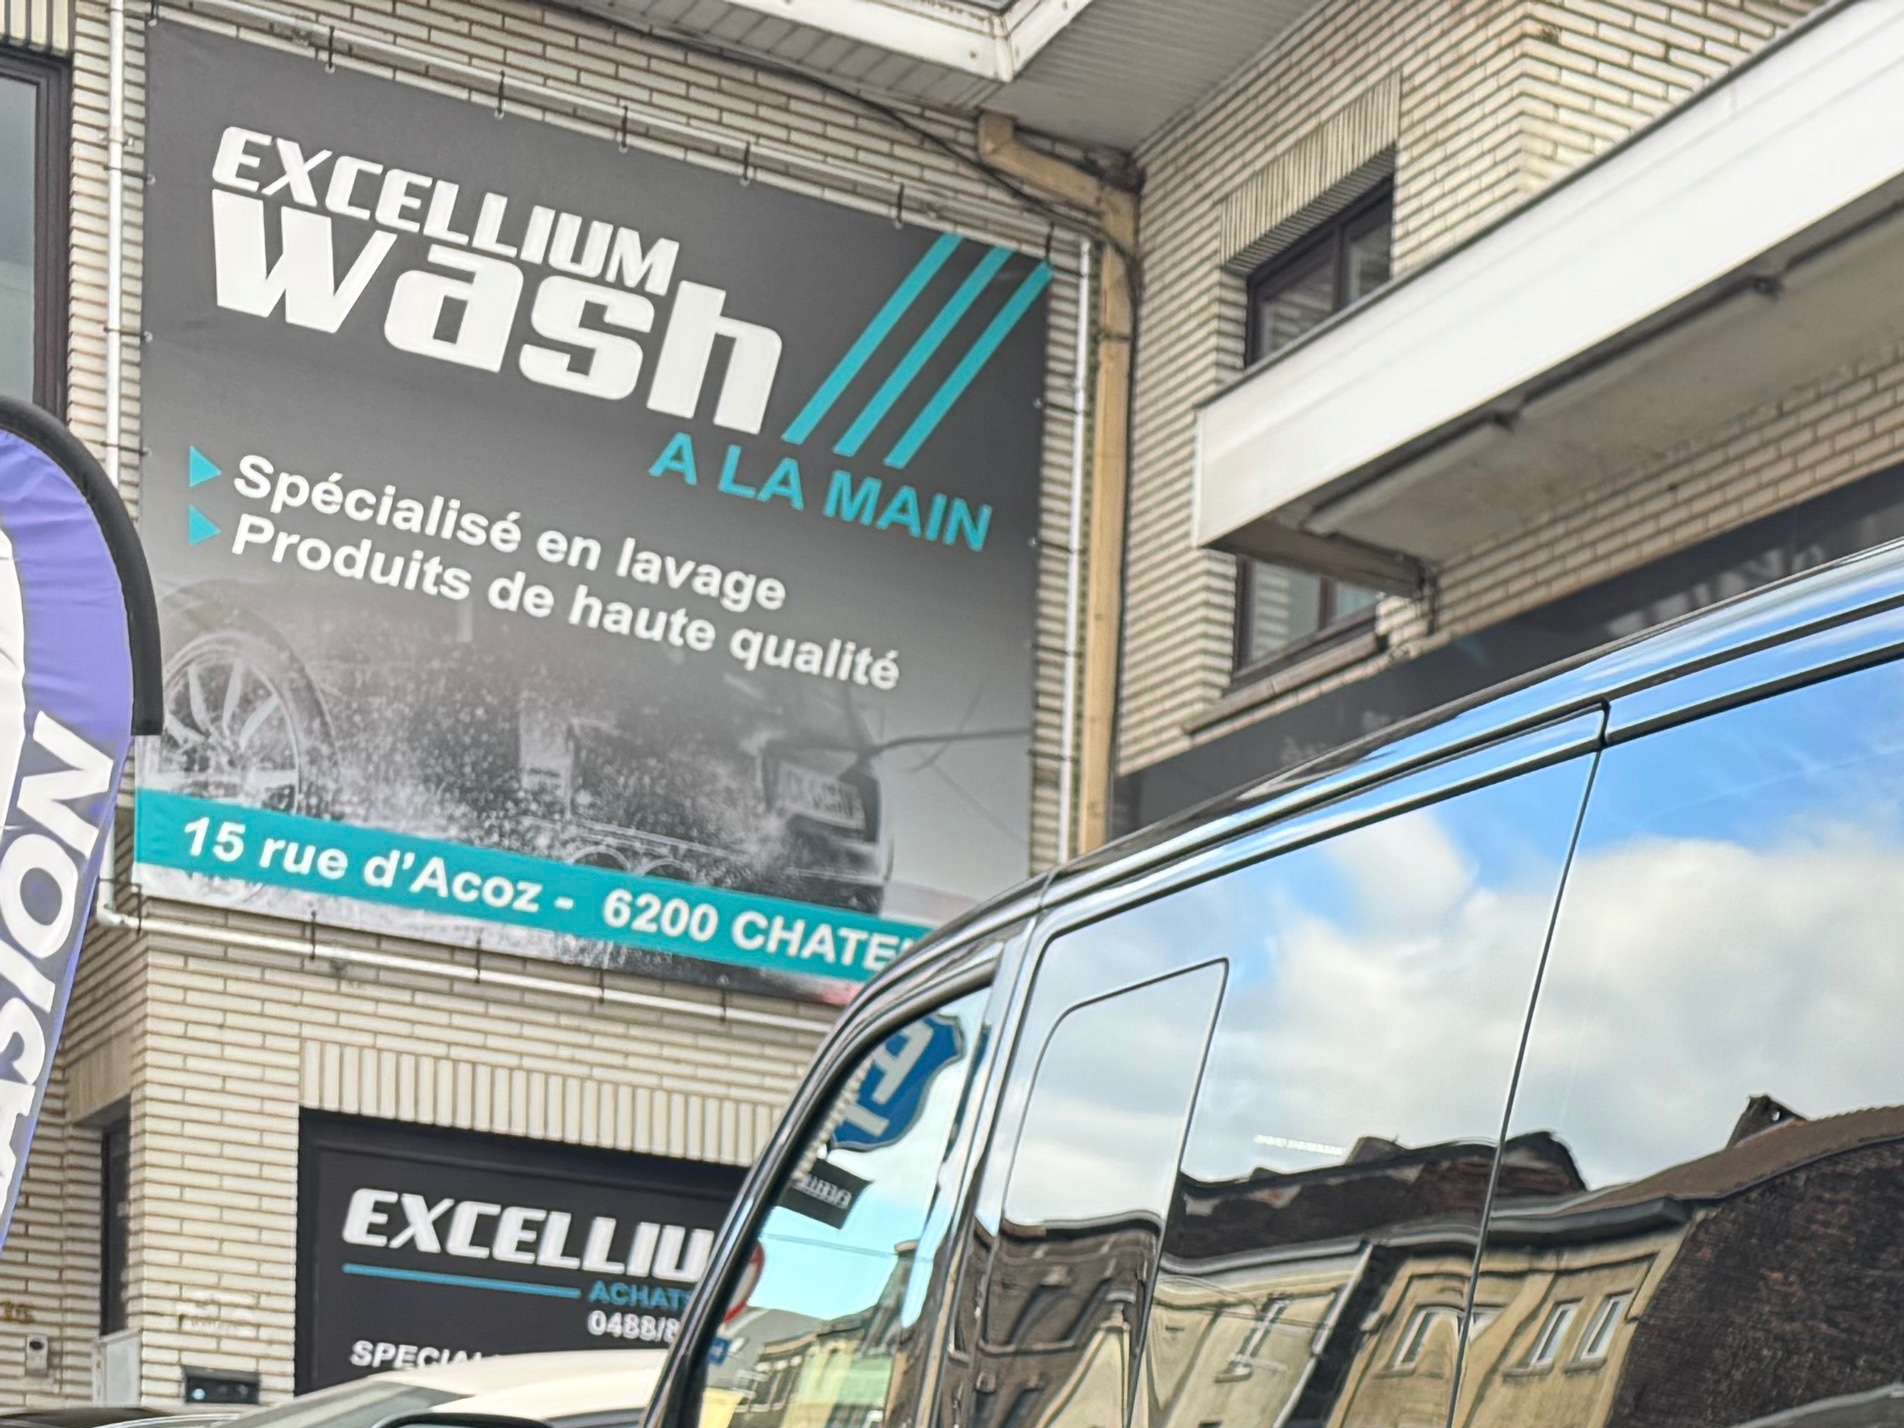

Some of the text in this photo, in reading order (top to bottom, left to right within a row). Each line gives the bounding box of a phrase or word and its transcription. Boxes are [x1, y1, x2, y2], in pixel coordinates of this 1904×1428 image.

[211, 126, 680, 297] EXCELLIUM
[232, 453, 788, 615] Spécialisé en lavage
[648, 431, 994, 553] A LA MAIN
[231, 512, 901, 692] Produits de haute qualité
[183, 814, 246, 862] 15
[258, 835, 348, 882] rue
[601, 888, 717, 943] 6200
